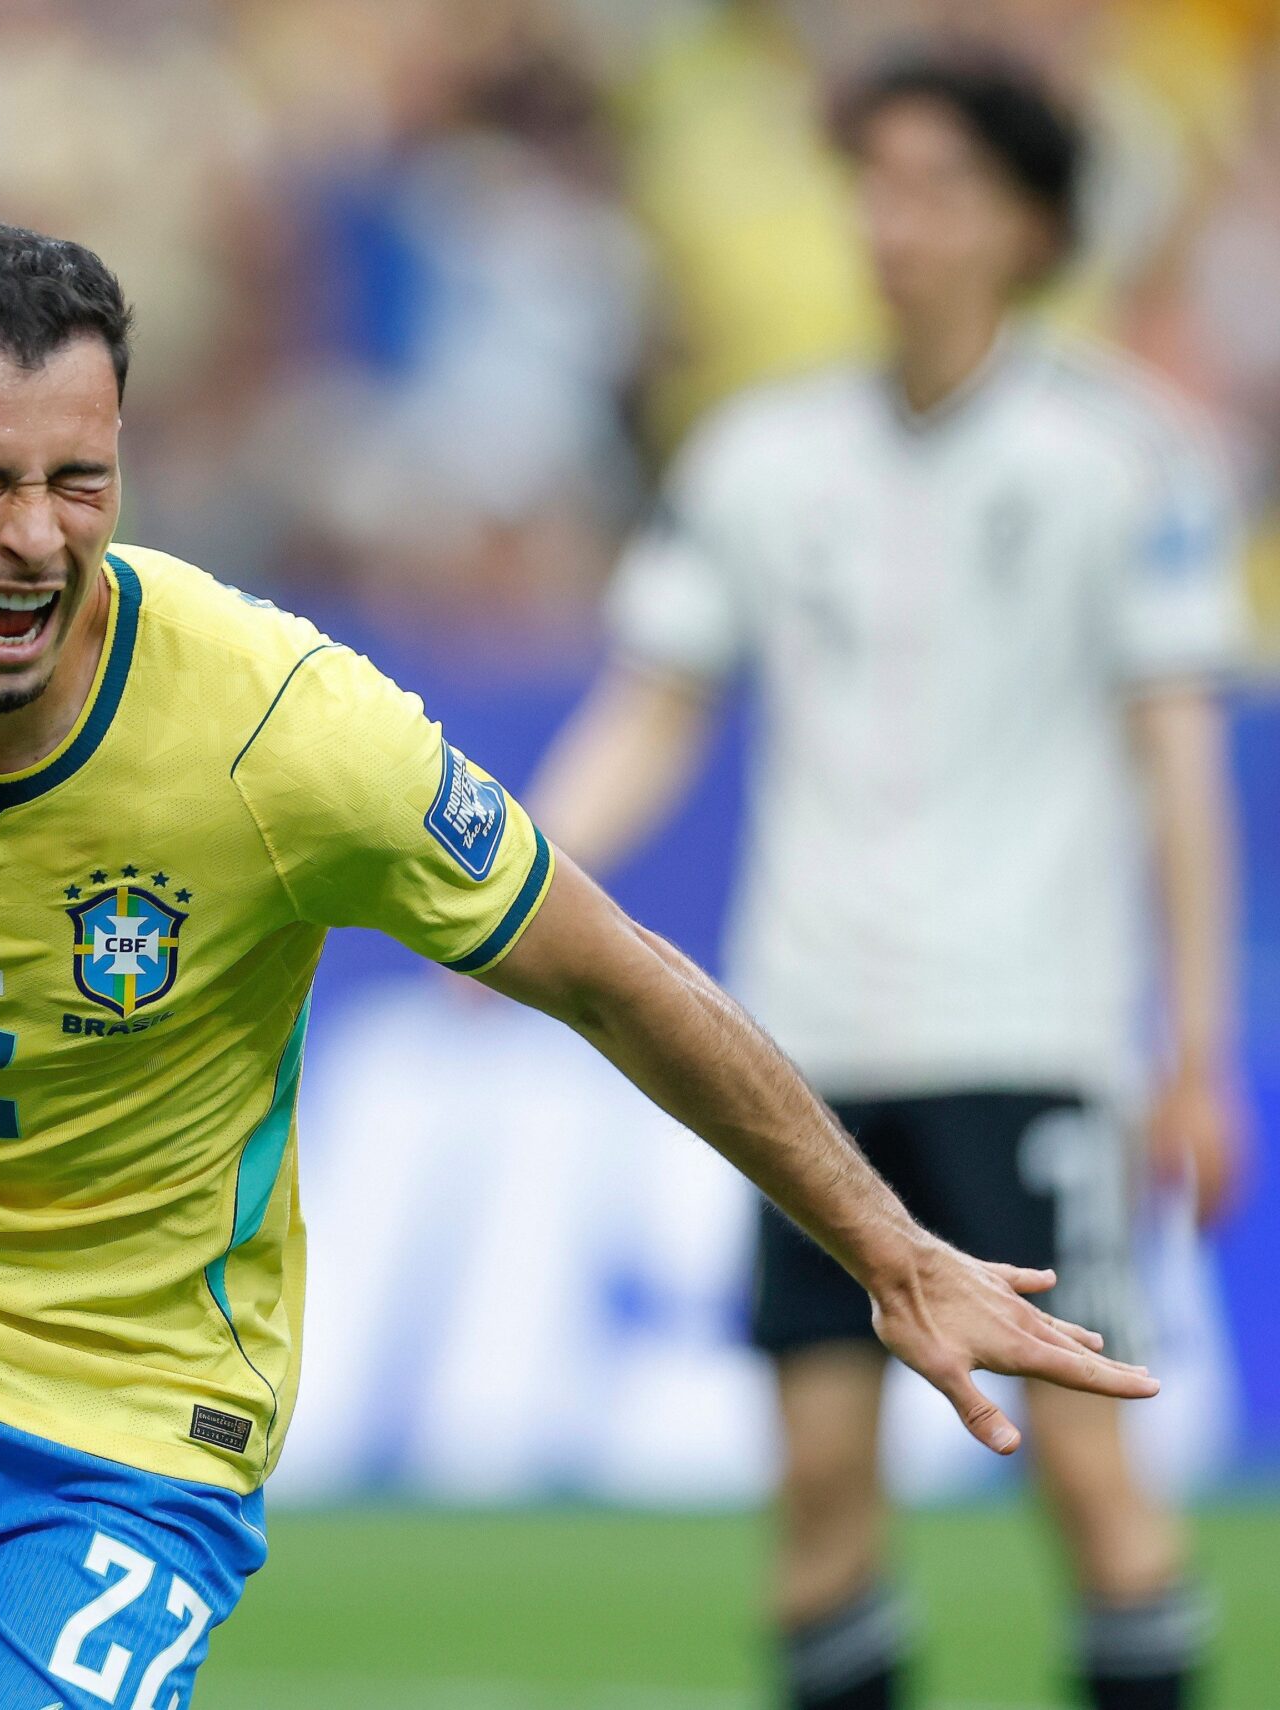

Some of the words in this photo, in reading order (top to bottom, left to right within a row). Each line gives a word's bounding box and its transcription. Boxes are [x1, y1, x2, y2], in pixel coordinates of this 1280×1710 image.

[462, 822, 481, 849] the
[104, 937, 148, 953] CBF
[47, 1530, 214, 1710] 22
